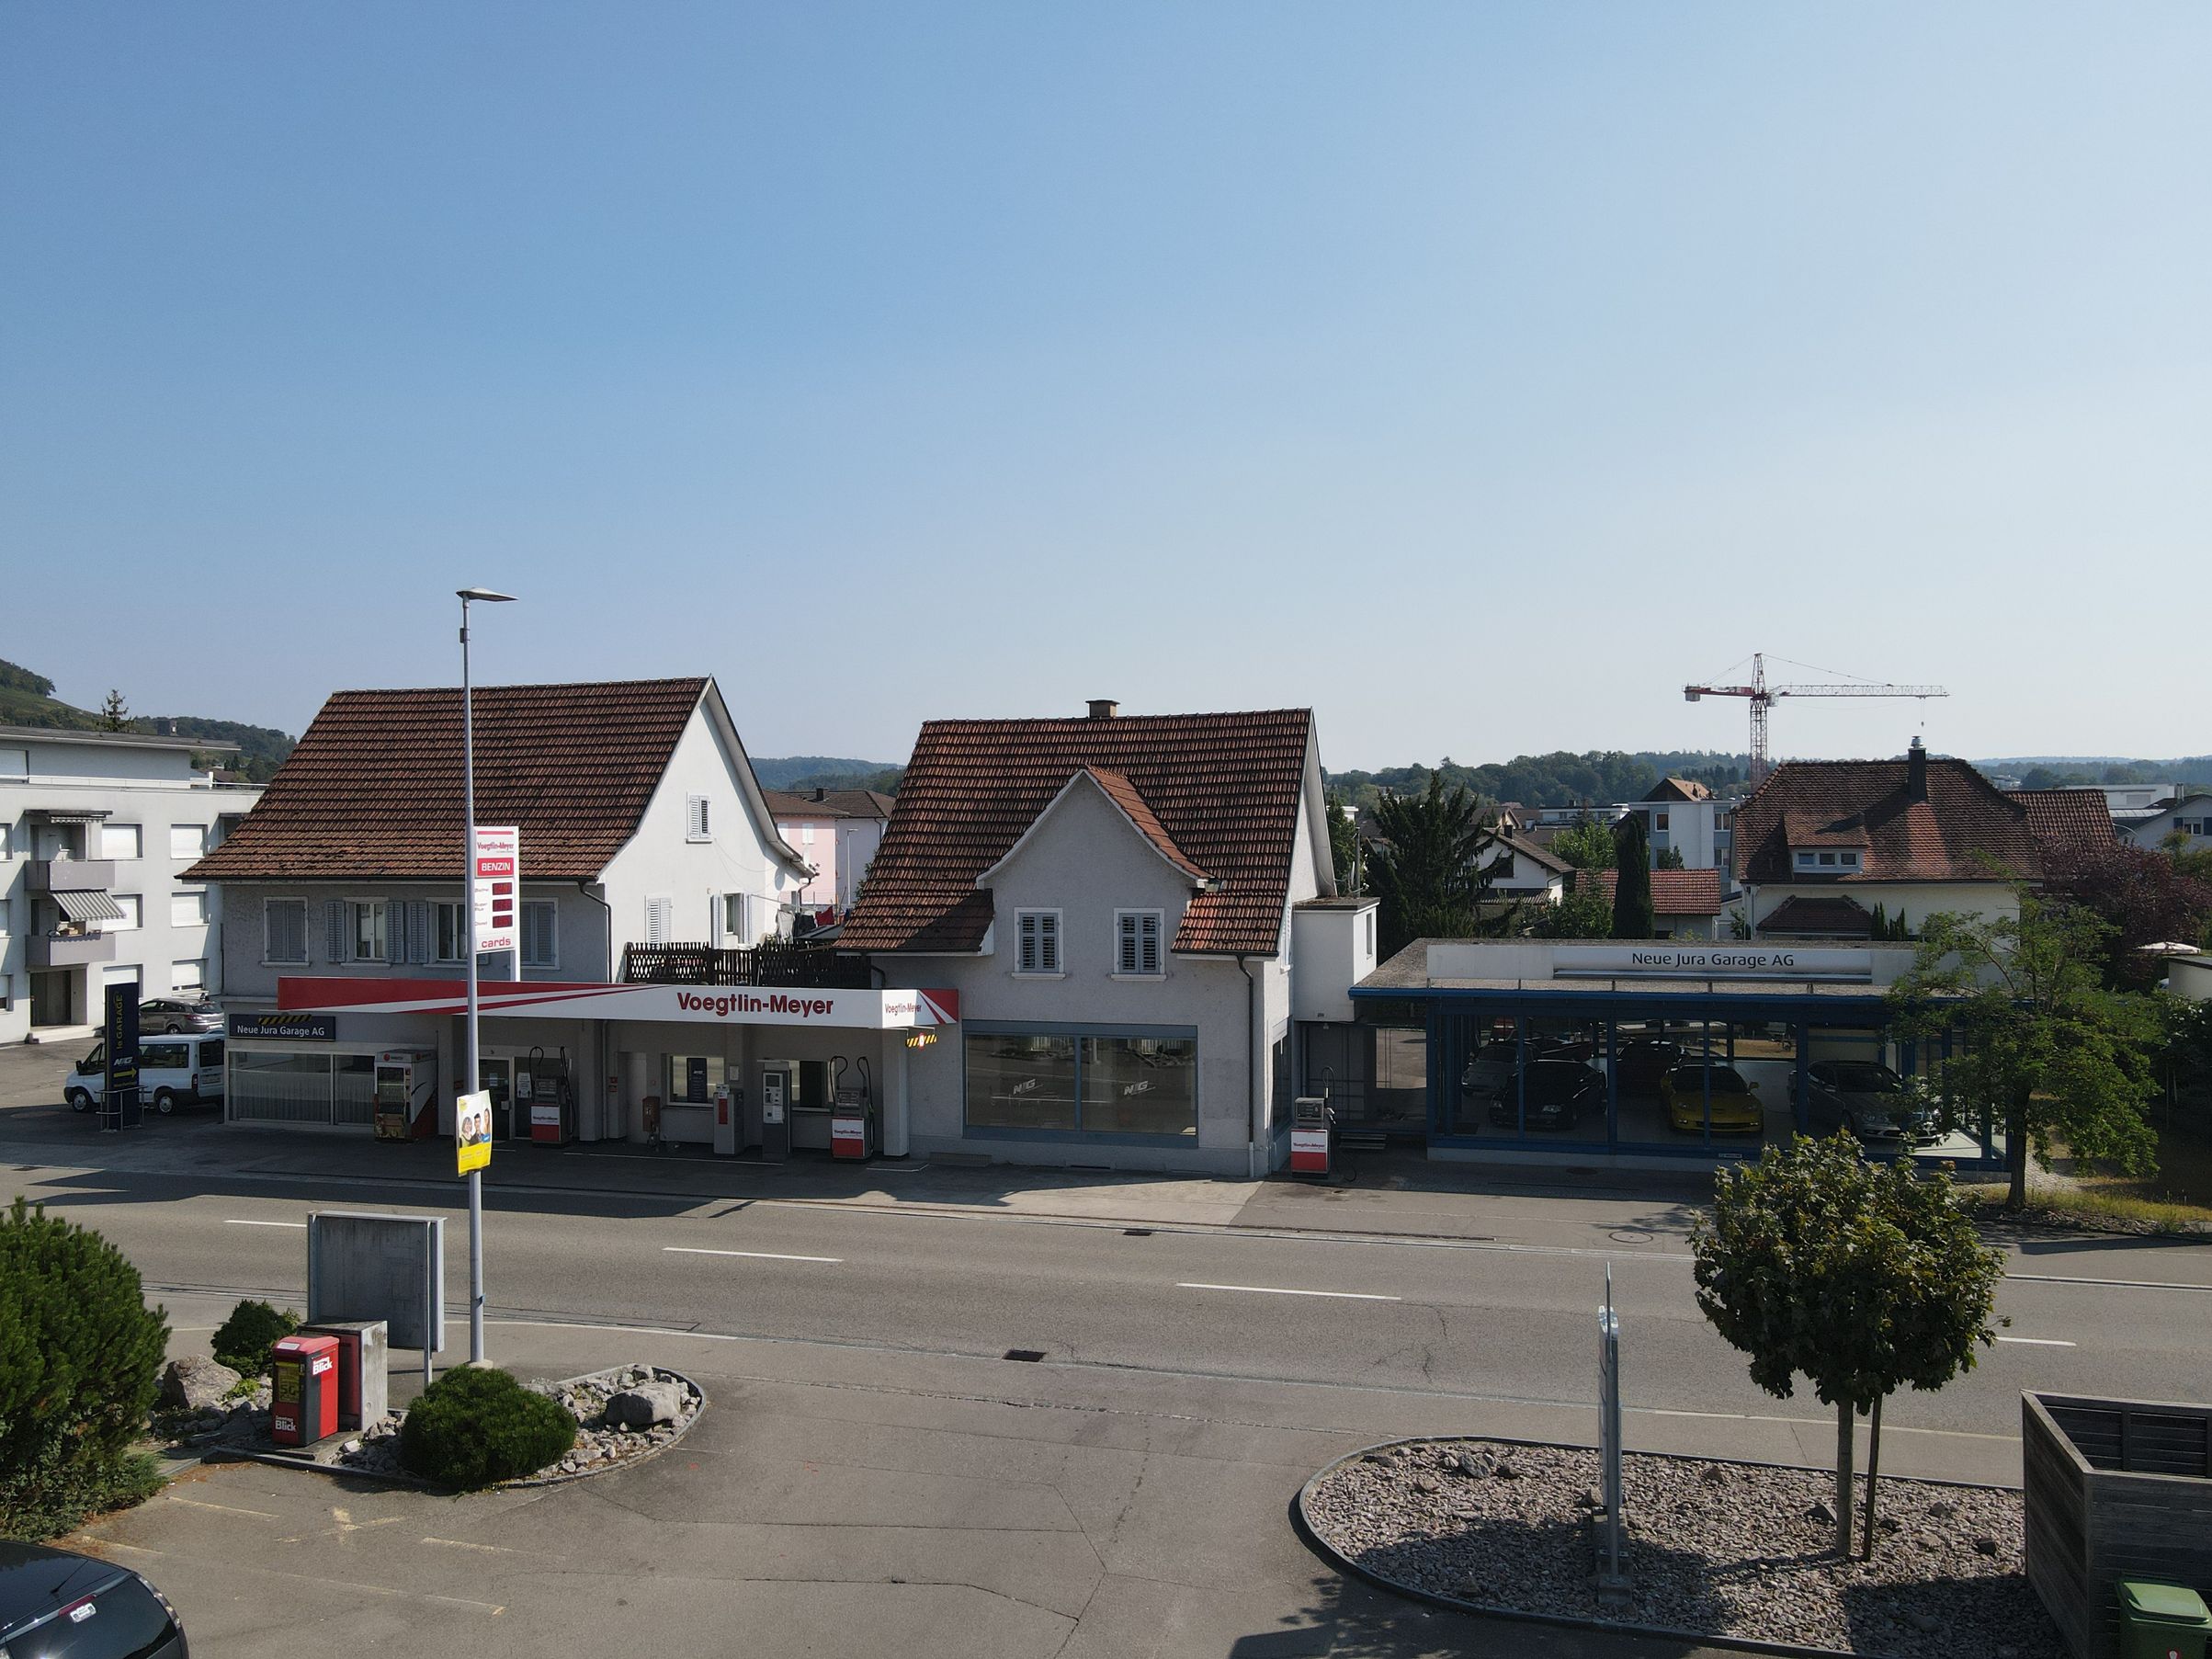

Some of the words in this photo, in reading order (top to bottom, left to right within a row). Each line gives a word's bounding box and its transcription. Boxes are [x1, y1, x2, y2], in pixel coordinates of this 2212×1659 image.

[482, 862, 511, 871] BENZIN
[482, 937, 511, 948] cards
[1632, 952, 1672, 965] Neue
[1675, 953, 1706, 968] Jura
[1711, 953, 1766, 969] Garage
[1772, 954, 1794, 966] AG
[676, 992, 834, 1018] Voegtlin-Meyer
[237, 1025, 258, 1034] Neue
[260, 1026, 278, 1035] Jura
[279, 1026, 310, 1038] Garage
[312, 1027, 325, 1036] AG
[312, 1358, 333, 1375] Blick
[276, 1420, 296, 1432] Blick
